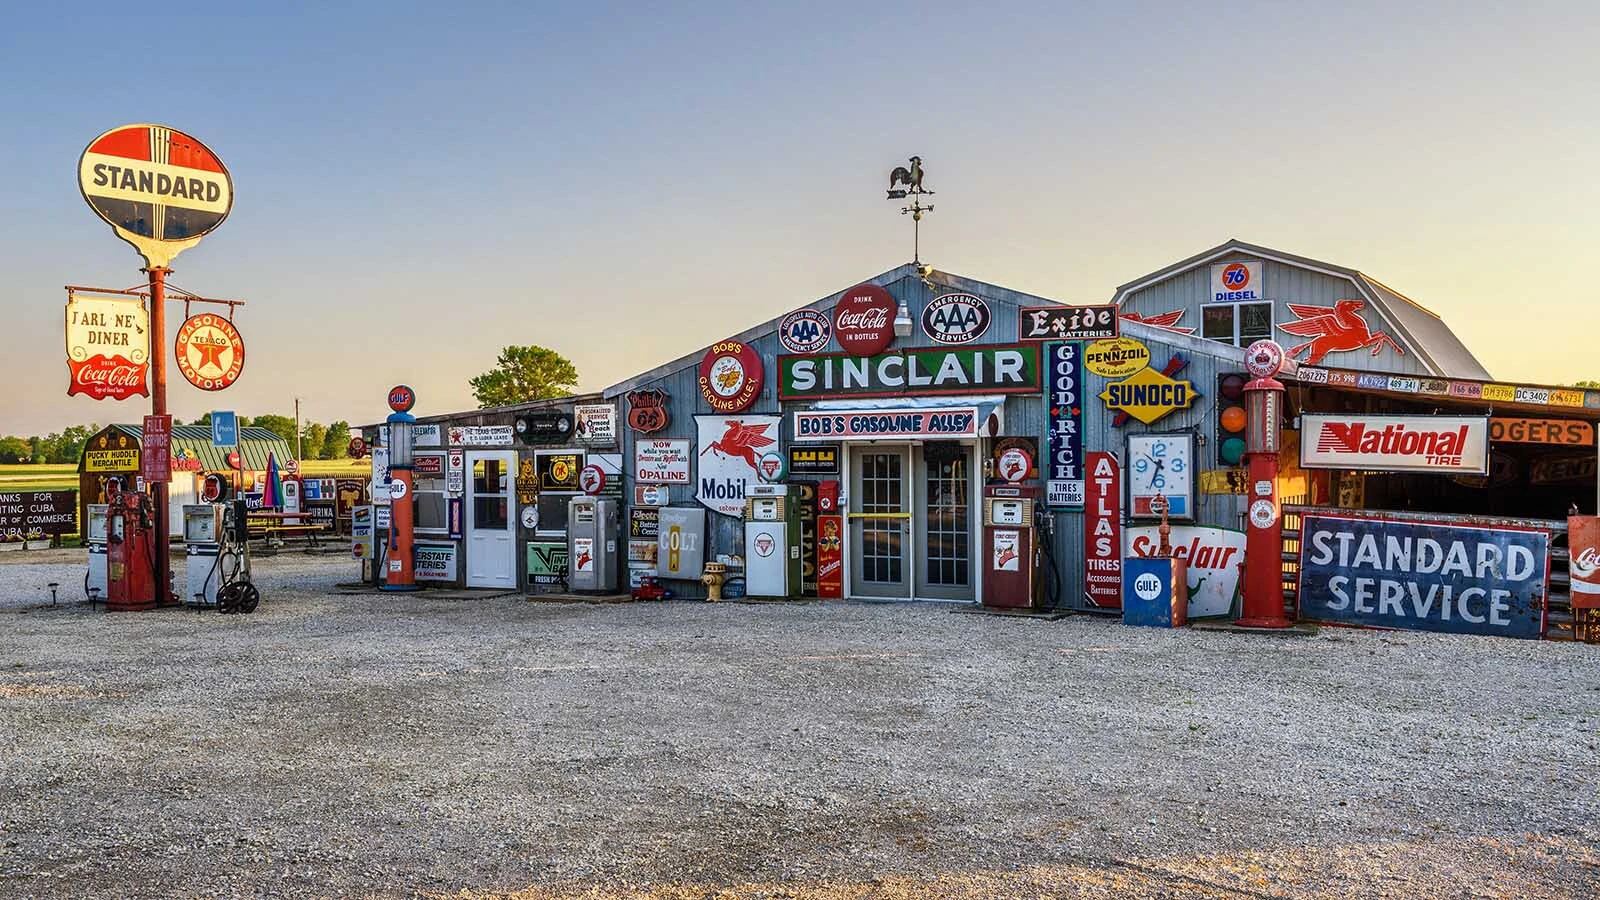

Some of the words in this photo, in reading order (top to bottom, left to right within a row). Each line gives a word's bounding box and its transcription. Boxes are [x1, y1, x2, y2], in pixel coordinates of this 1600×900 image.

[93, 163, 221, 202] STANDARD
[1225, 268, 1246, 285] 76
[929, 295, 982, 312] EMERGENCY
[1215, 291, 1257, 301] DIESEL
[836, 307, 889, 330] Coca-Cola
[932, 303, 979, 333] AAA
[1028, 308, 1111, 337] Exide
[88, 330, 129, 346] DINER
[179, 316, 241, 346] GASOLINE
[791, 320, 820, 342] AAA
[854, 332, 879, 341] BOTTLES
[935, 332, 973, 341] SERVICE
[1059, 330, 1112, 338] BATTERIES
[194, 336, 226, 345] TEXACO
[712, 342, 742, 354] BOB'S
[1087, 348, 1148, 363] PENNZOIL
[77, 364, 141, 386] Coca-Cola
[178, 356, 224, 389] MOTOR
[226, 360, 241, 381] OIL
[791, 350, 1025, 390] SINCLAIR
[390, 393, 409, 404] GULF
[699, 376, 734, 410] GASOLINE
[736, 377, 756, 407] ALLEY
[1108, 384, 1187, 406] SUNOCO
[636, 409, 660, 427] 66
[800, 416, 845, 434] BOB'S
[849, 413, 924, 433] GASOLINE
[928, 412, 974, 432] ALLEY
[144, 434, 168, 447] SERVICE
[1316, 421, 1470, 456] National
[87, 450, 110, 459] PUCKY
[111, 450, 137, 458] HUDDLE
[1151, 443, 1166, 458] 12
[92, 458, 132, 467] MERCANTILE
[1135, 459, 1148, 473] 9
[1171, 458, 1184, 473] 3
[1425, 456, 1462, 466] TIRE
[640, 469, 686, 480] OPALINE
[1153, 475, 1166, 489] 6
[390, 484, 405, 493] GULF
[702, 478, 746, 500] Mobil
[1054, 483, 1077, 492] TIRES
[33, 493, 53, 501] FOR
[1049, 492, 1082, 502] BATTERIES
[30, 504, 55, 512] CUBA
[1094, 457, 1114, 557] ATLAS
[26, 513, 73, 524] COMMERCE
[1310, 530, 1535, 582] STANDARD
[1087, 558, 1121, 571] TIRES
[1090, 584, 1118, 596] BATTERIES
[1136, 580, 1158, 592] GULF
[1326, 575, 1512, 626] SERVICE
